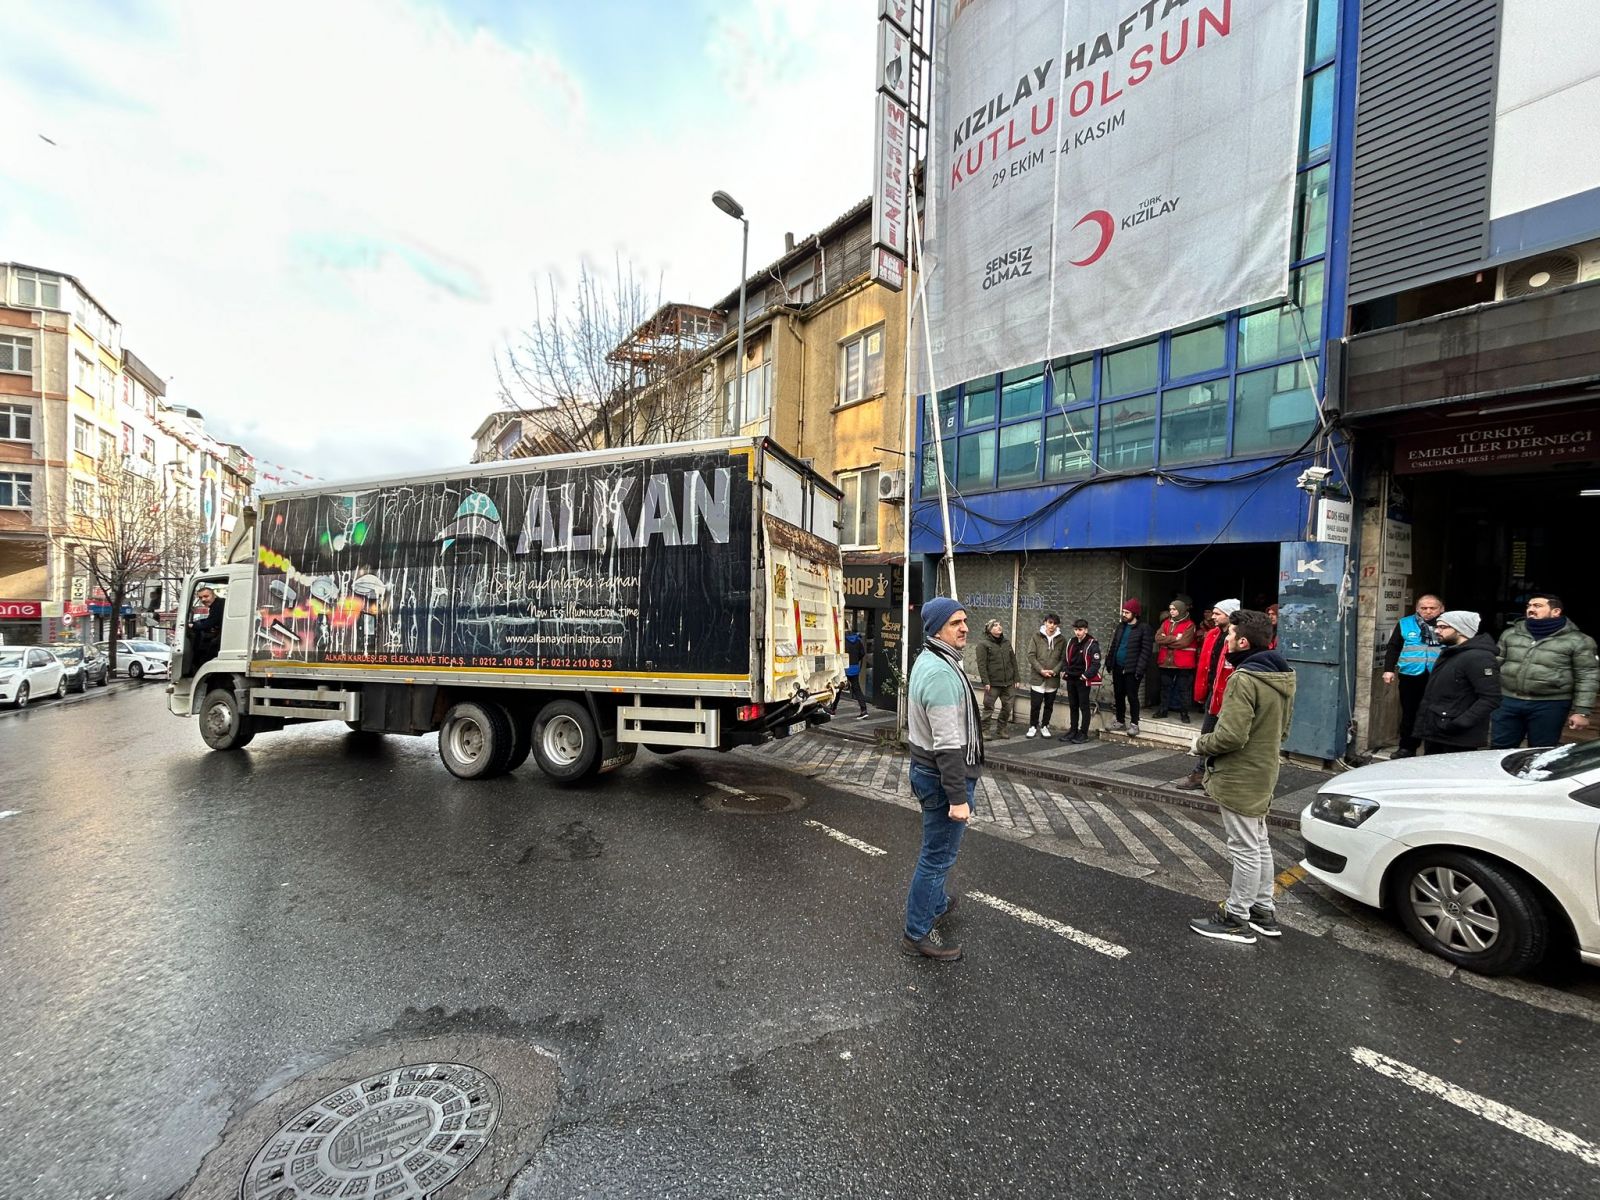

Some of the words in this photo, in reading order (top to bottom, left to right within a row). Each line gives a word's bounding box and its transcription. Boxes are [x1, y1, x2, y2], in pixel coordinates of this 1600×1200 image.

[951, 97, 1053, 193] KUTLU
[1070, 0, 1231, 118] OLSUN
[953, 58, 1054, 153] KIZILAY
[991, 168, 1007, 189] 29
[1010, 148, 1044, 178] EKİM
[1060, 138, 1070, 155] 4
[1074, 110, 1126, 149] KASIM
[1121, 197, 1181, 231] KIZILAY
[1138, 194, 1162, 210] TÜRK
[982, 261, 1032, 290] OLMAZ
[1408, 441, 1502, 460] EMEKLİLER
[1506, 430, 1593, 450] DERNEĞİ
[1456, 425, 1535, 444] TÜRKİYE
[515, 467, 731, 555] ALKAN
[527, 601, 548, 619] Now
[505, 633, 623, 646] www.alkanaydinlatma.com
[325, 653, 348, 662] ALKAN
[348, 654, 387, 663] KARDEŞLER
[479, 657, 497, 666] 0212
[513, 658, 523, 666] 06
[525, 658, 535, 667] 26
[551, 659, 570, 668] 0212
[589, 659, 600, 668] 06
[601, 659, 612, 668] 33
